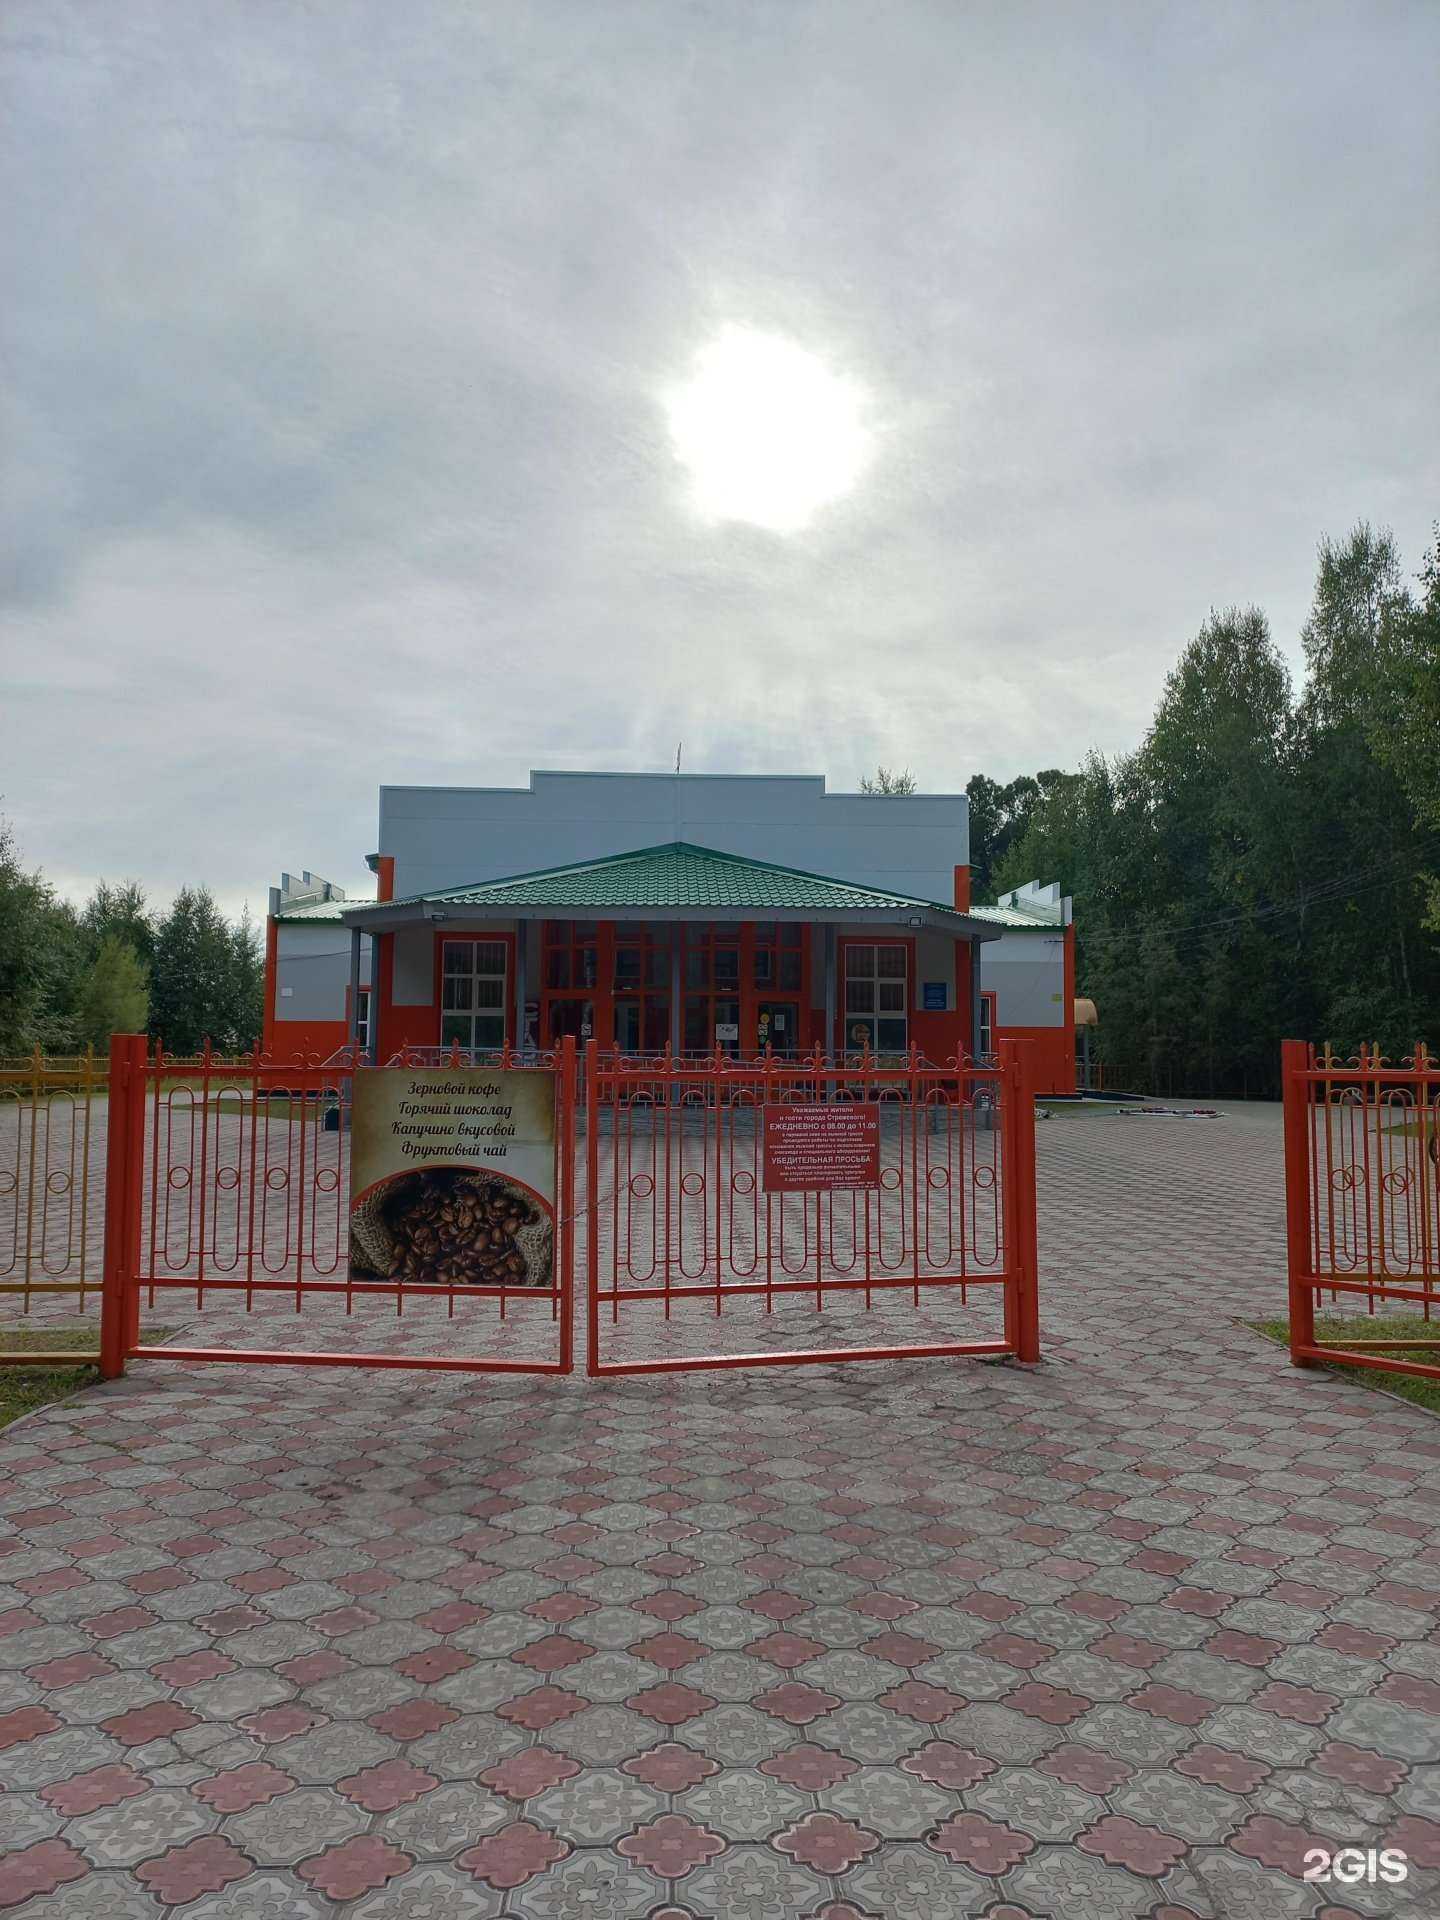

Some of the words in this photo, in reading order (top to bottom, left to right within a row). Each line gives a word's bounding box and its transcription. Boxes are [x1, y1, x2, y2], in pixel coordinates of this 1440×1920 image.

[408, 1082, 465, 1098] Зерновой
[468, 1084, 500, 1098] кофе
[399, 1102, 451, 1118] Горячий
[453, 1104, 512, 1119] шоколад
[391, 1121, 455, 1138] Капучино
[458, 1122, 515, 1139] вкусовой
[401, 1141, 479, 1158] Фруктовый
[483, 1144, 507, 1156] чай
[771, 1156, 833, 1165] УБЕДИТЕЛЬНАЯ
